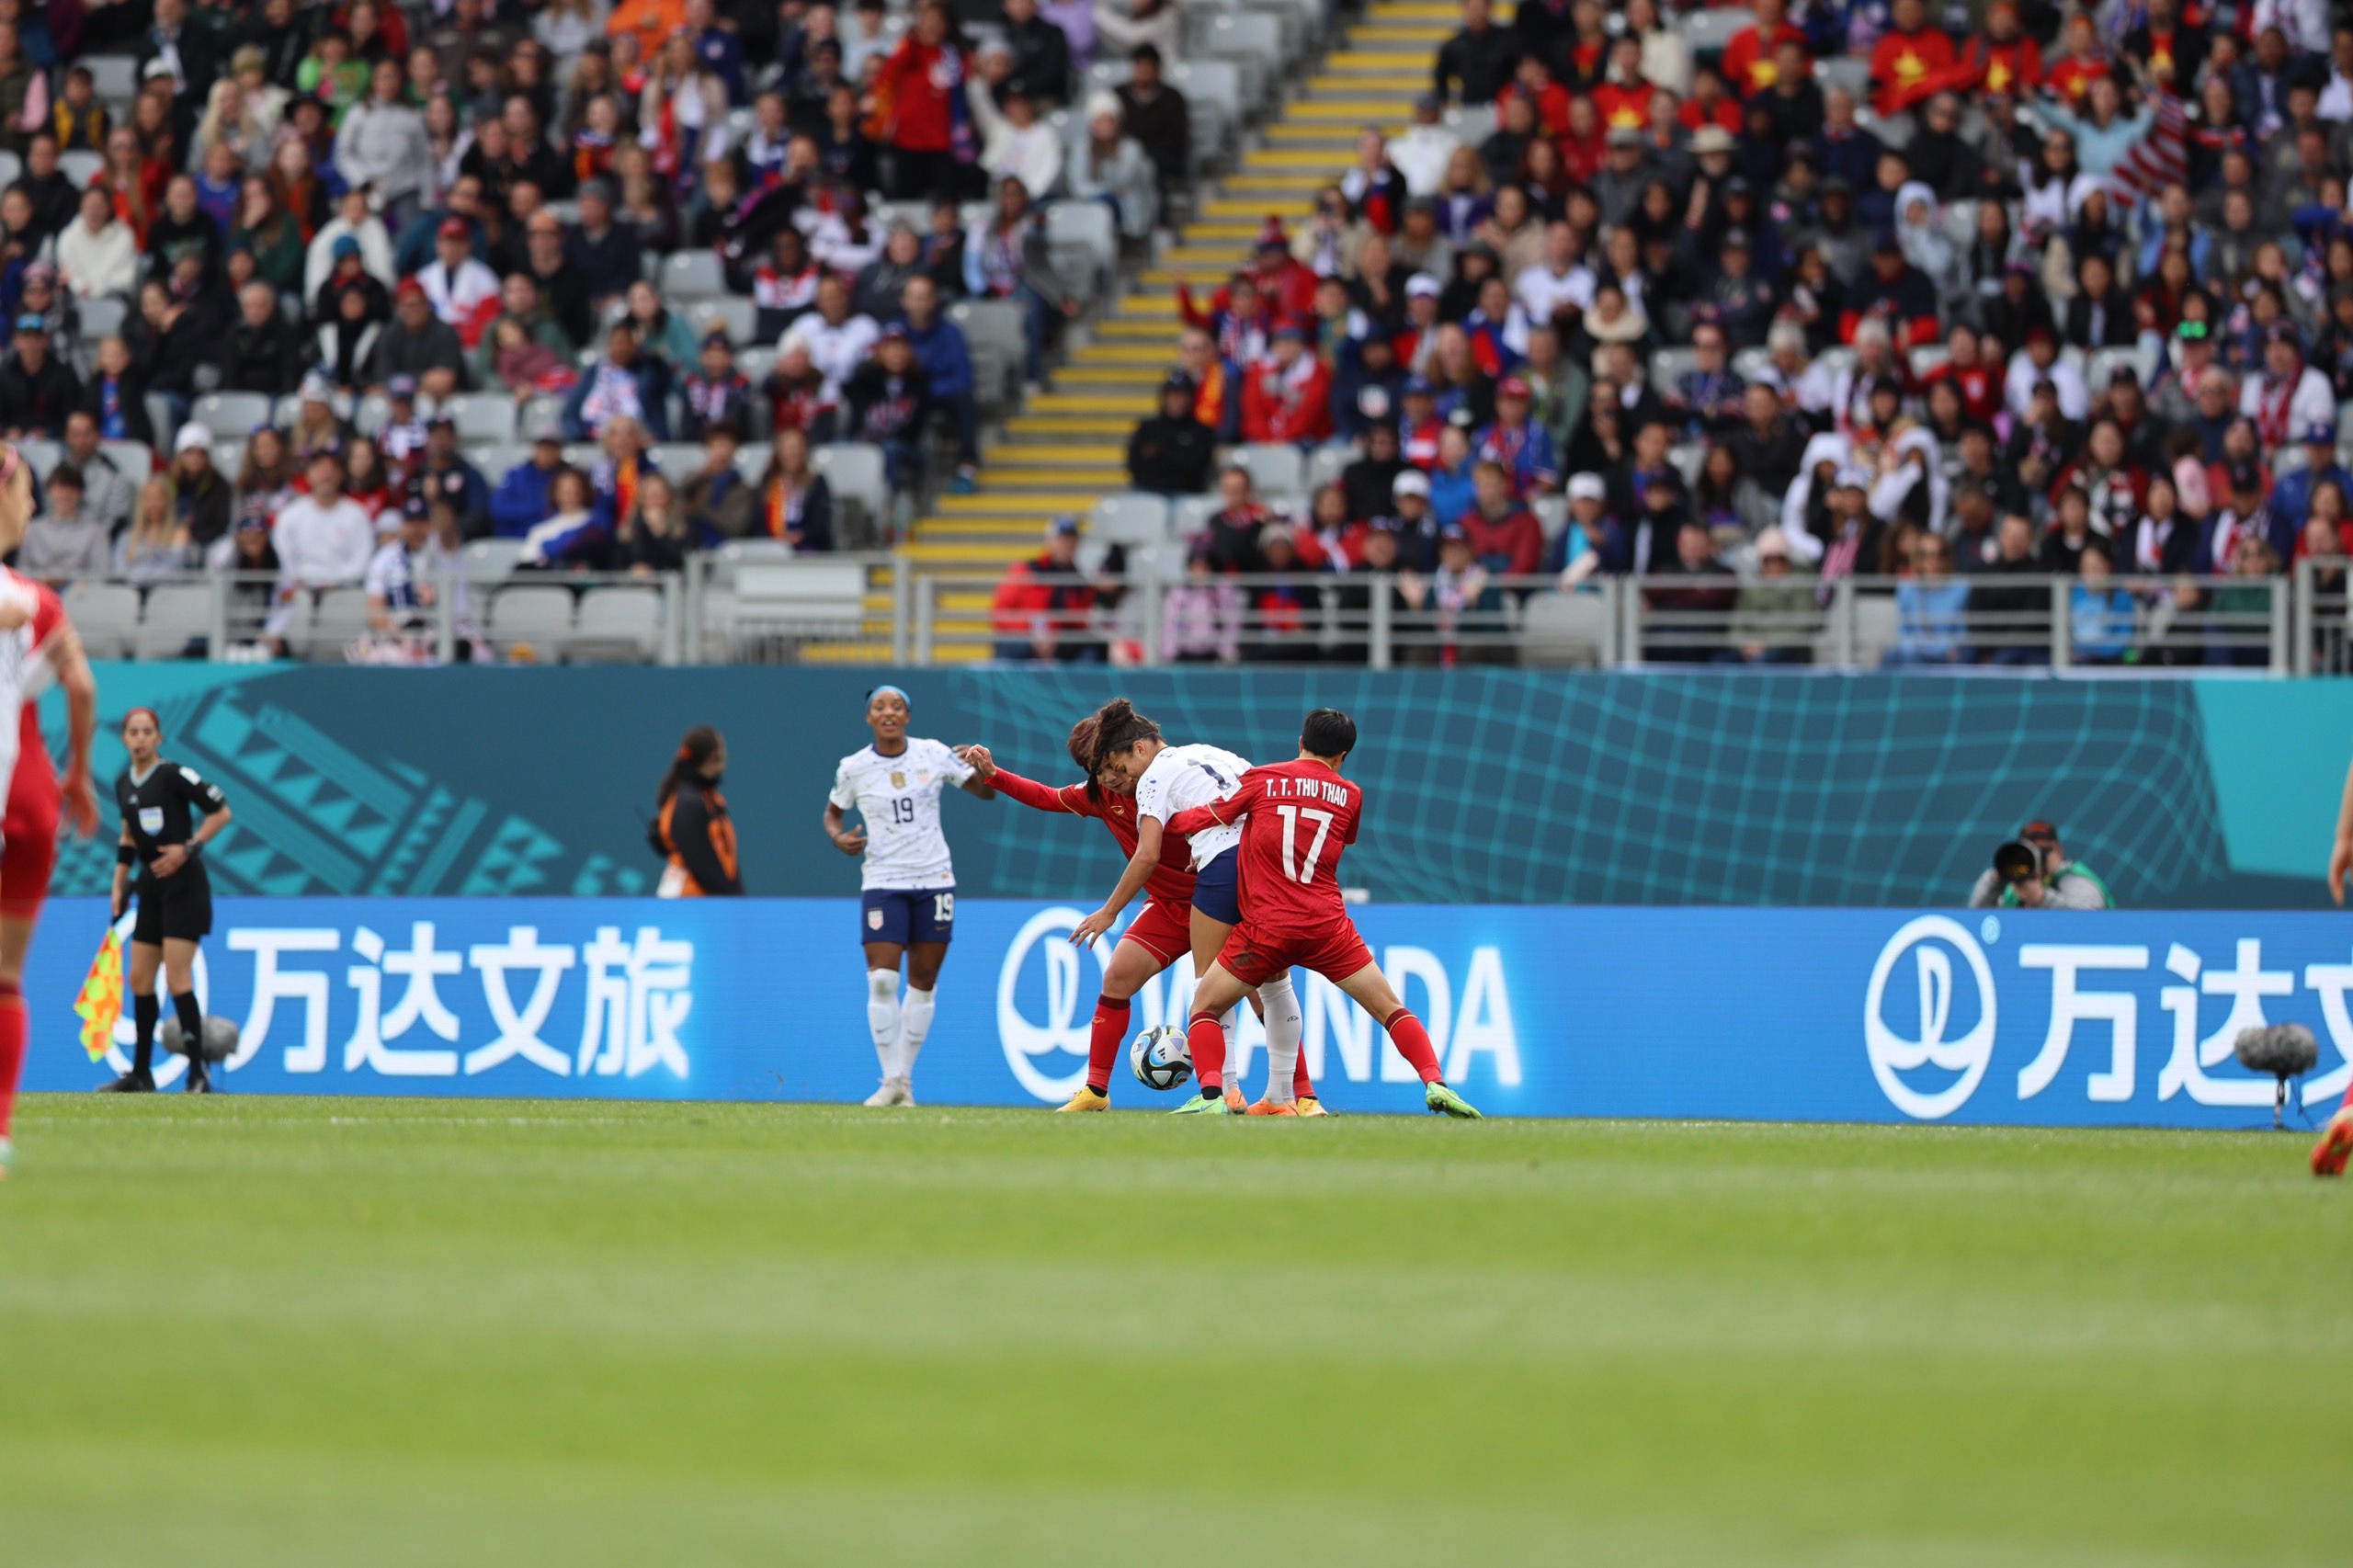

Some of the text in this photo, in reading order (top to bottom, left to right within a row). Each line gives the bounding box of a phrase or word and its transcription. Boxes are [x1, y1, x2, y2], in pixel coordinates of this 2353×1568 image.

[1266, 778, 1347, 808] T. T. THU THAO
[892, 797, 914, 824] 19
[1276, 804, 1334, 883] 17
[934, 892, 955, 921] 19
[223, 920, 695, 1080] 万达文旅
